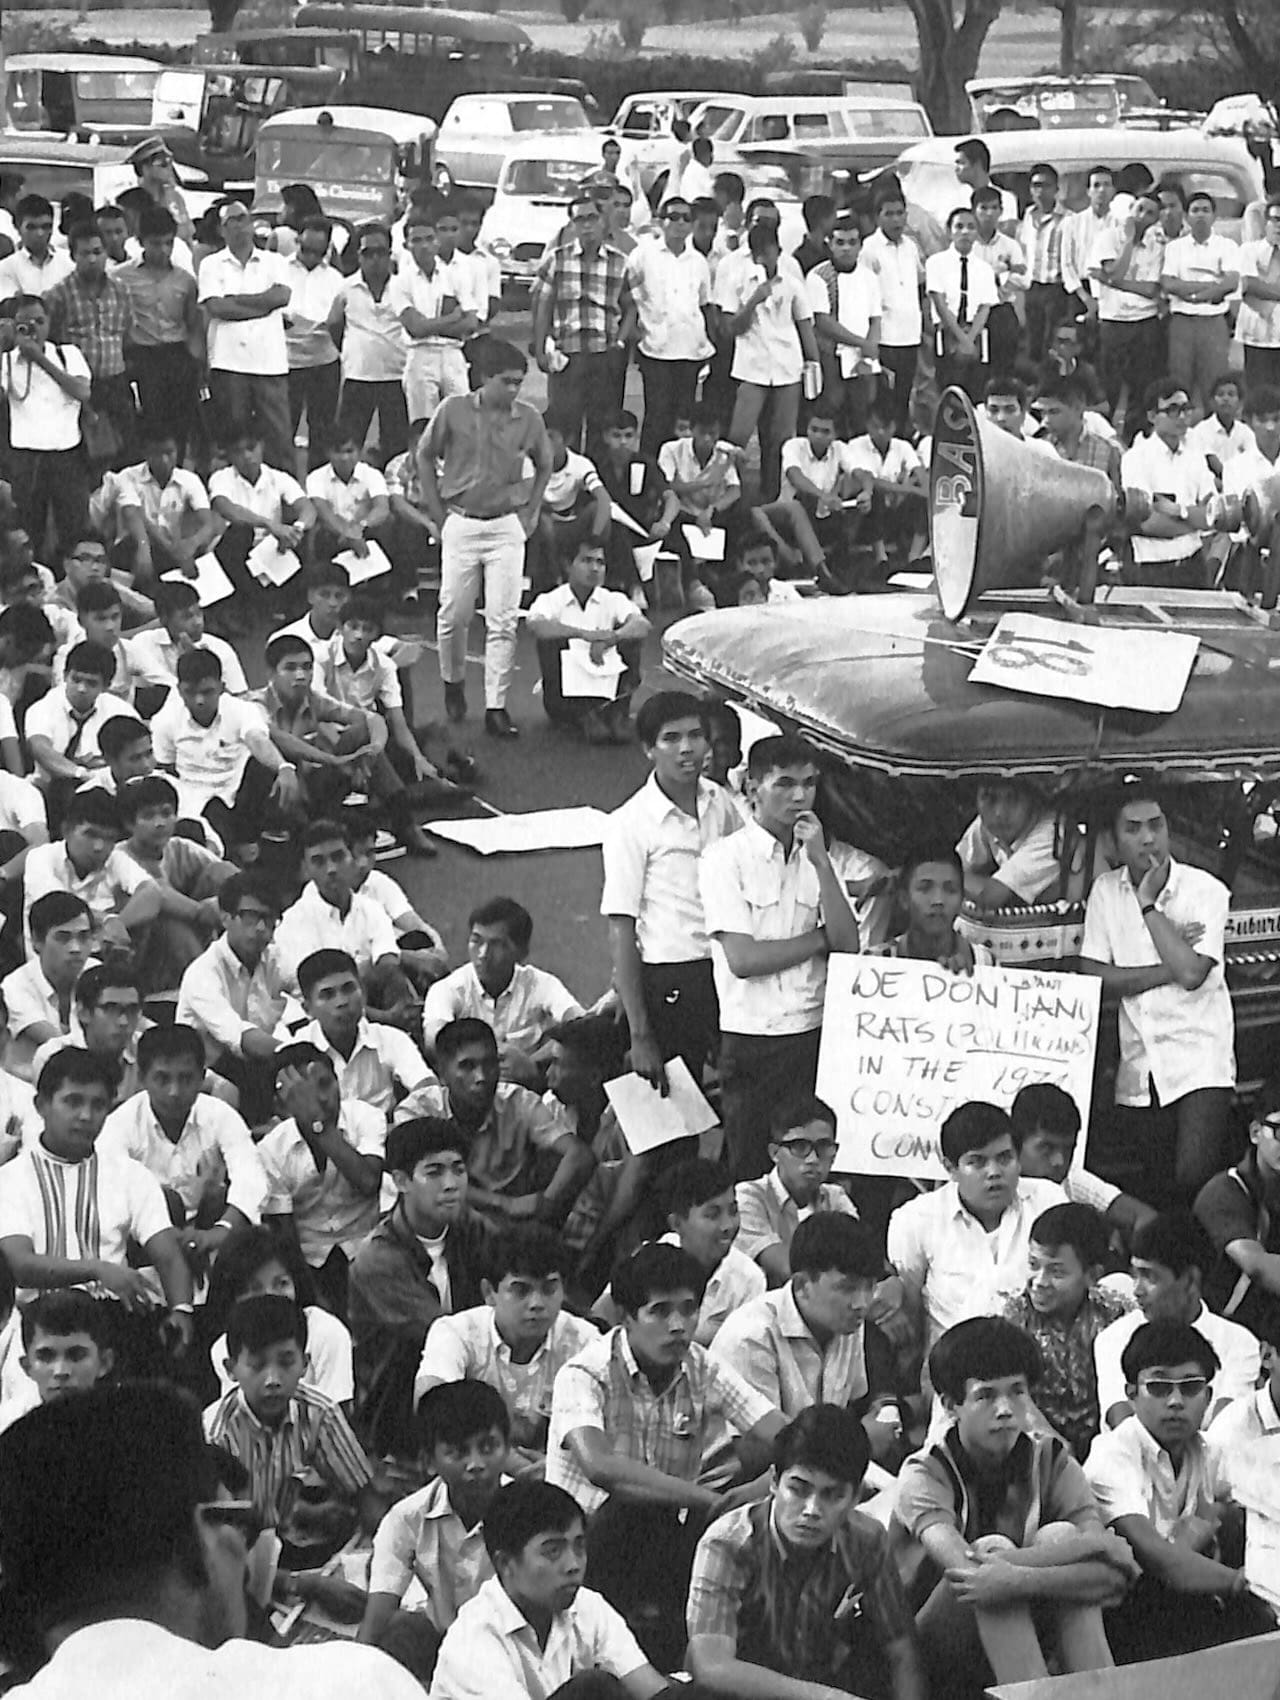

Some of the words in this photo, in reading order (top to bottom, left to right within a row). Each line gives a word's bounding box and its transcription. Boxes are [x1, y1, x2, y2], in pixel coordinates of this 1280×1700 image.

[851, 968, 905, 999] WE
[855, 1011, 937, 1045] RATS
[858, 1055, 884, 1075] IN
[902, 1056, 967, 1083] THE
